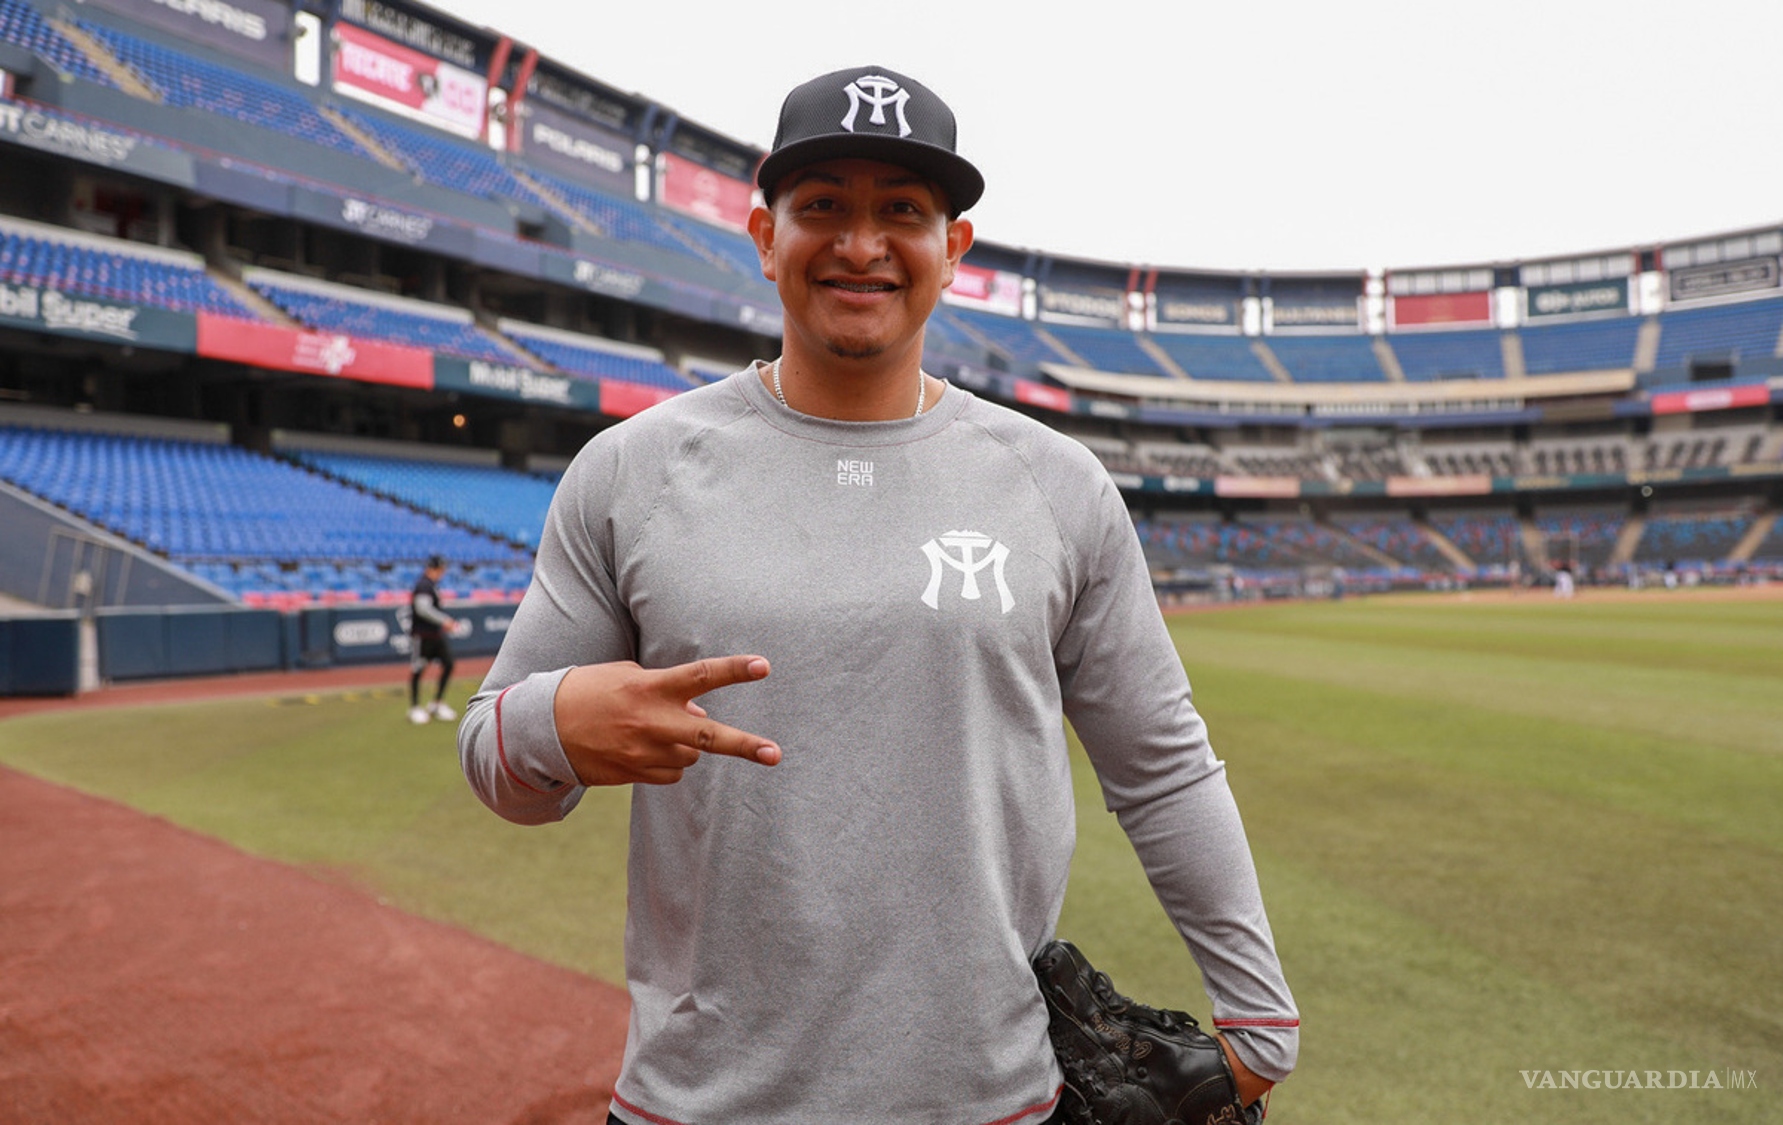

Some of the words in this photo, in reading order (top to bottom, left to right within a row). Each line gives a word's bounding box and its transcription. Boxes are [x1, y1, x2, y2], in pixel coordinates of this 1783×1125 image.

[41, 290, 138, 333] Super
[837, 460, 874, 473] NEW
[837, 473, 873, 486] ERA
